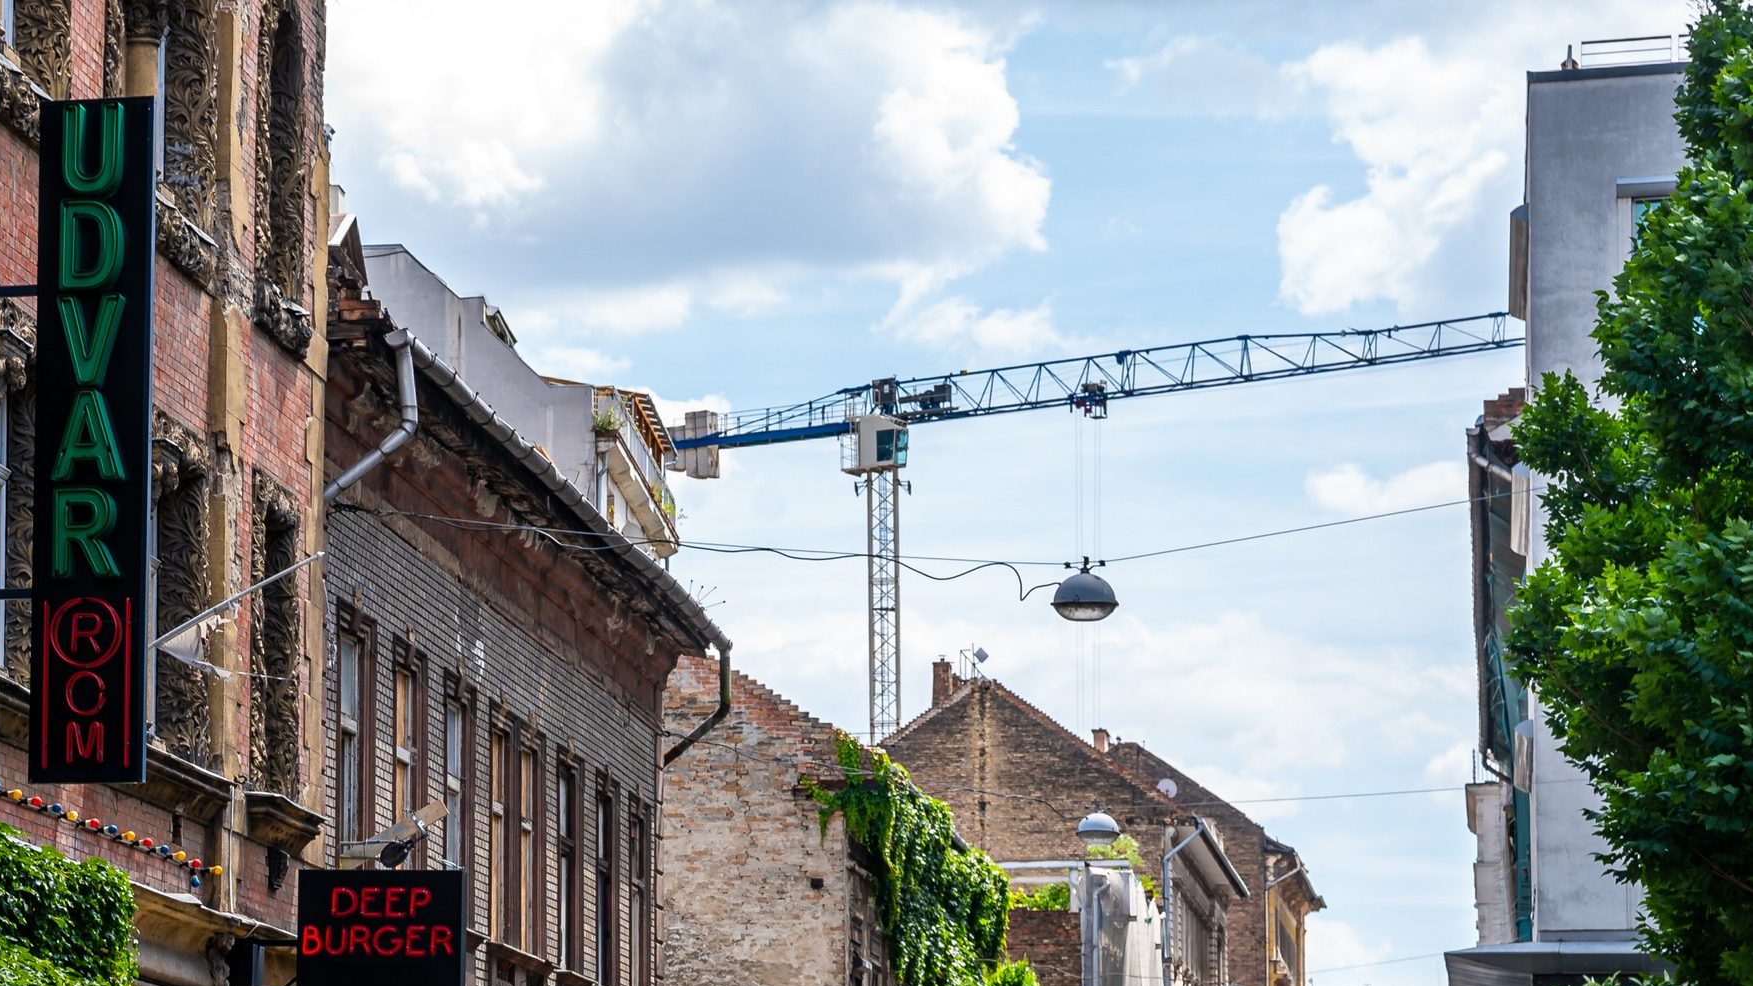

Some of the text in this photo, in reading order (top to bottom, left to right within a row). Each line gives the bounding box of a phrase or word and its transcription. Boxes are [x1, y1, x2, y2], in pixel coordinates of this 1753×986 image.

[50, 102, 126, 578] UDVAR
[331, 886, 432, 918] DEEP
[302, 924, 453, 957] BURGER
